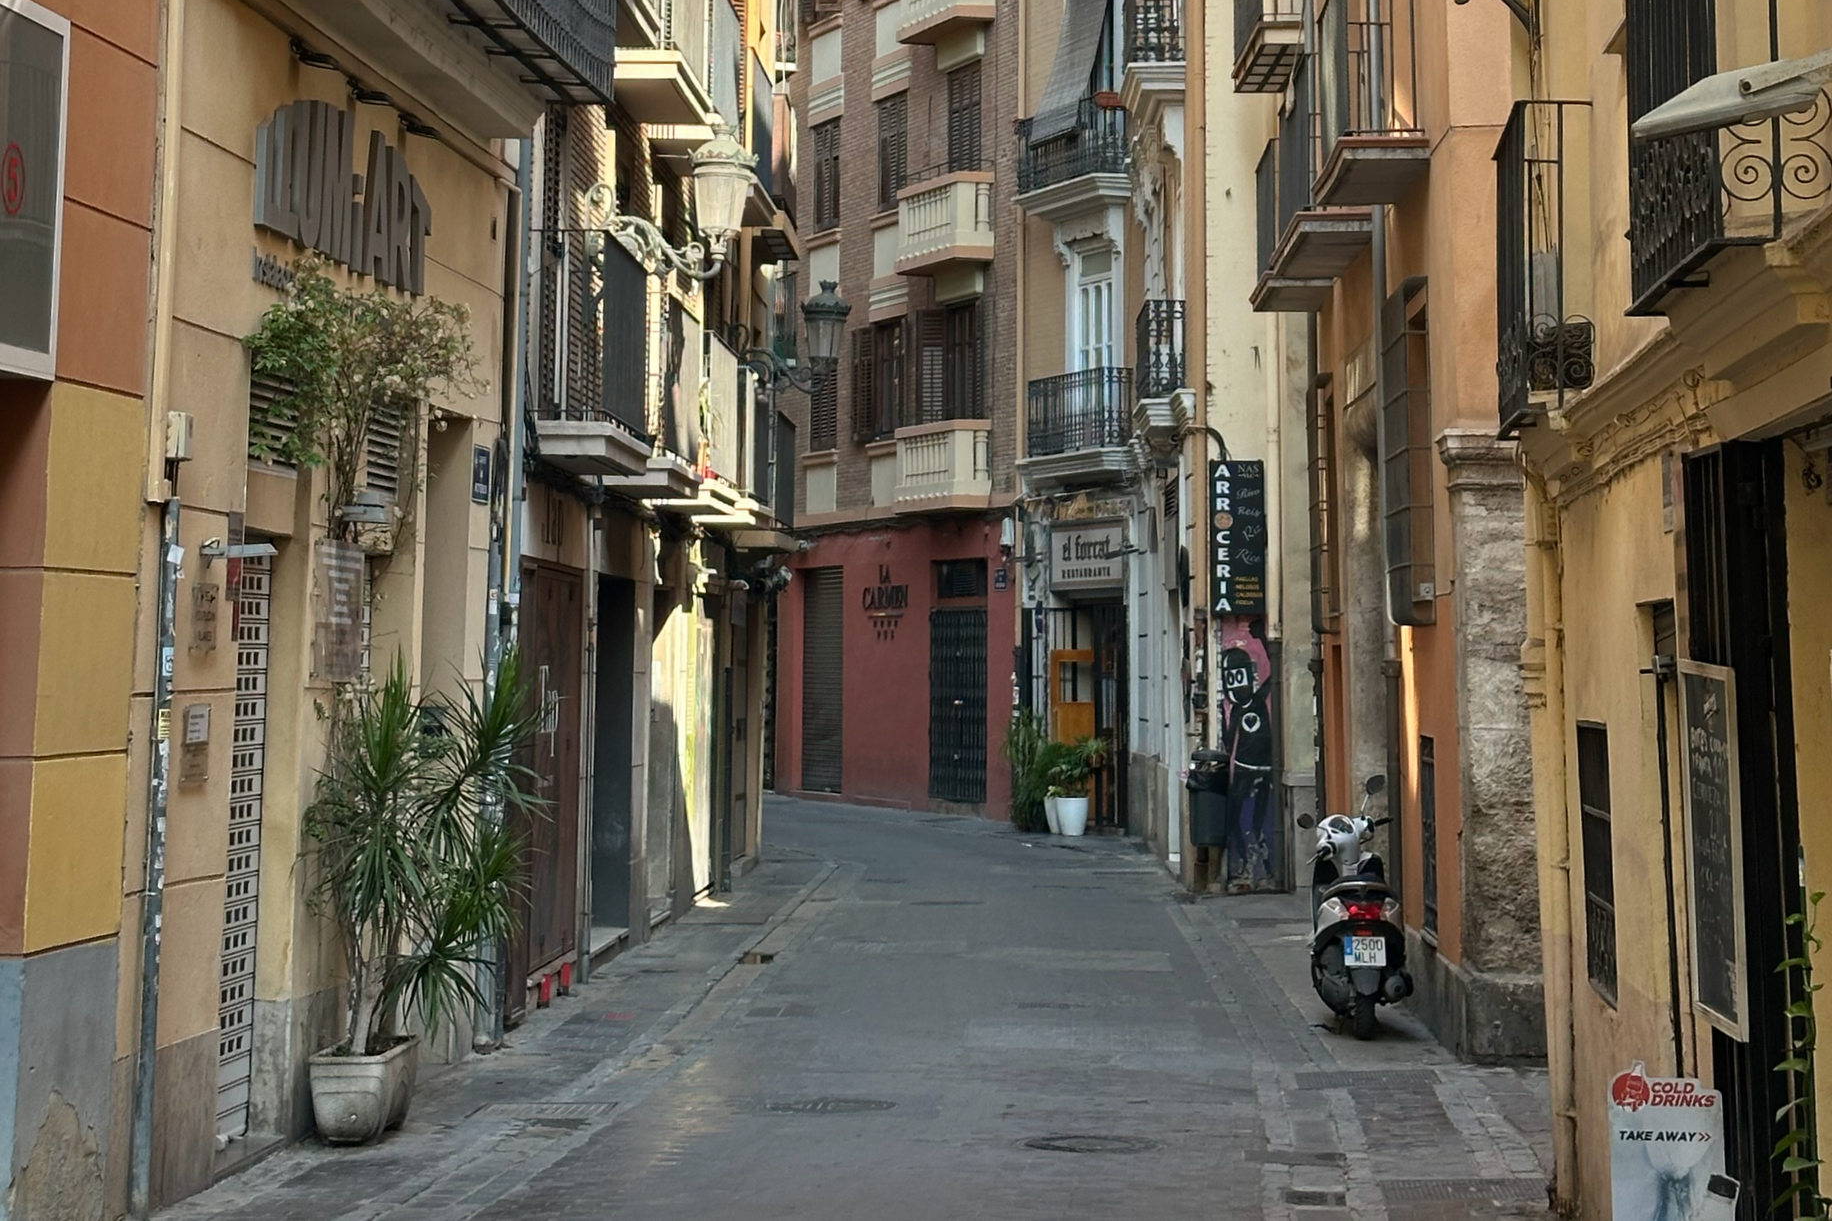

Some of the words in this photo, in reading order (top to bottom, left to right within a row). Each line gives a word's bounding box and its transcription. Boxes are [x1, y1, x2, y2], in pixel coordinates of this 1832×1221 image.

[7, 156, 20, 203] 5
[1062, 535, 1072, 561] el
[1235, 548, 1262, 565] Rice
[879, 564, 891, 584] LA
[1061, 566, 1111, 579] RESTAURANTE
[862, 584, 909, 610] CARMEN
[1354, 939, 1383, 951] 2500
[1354, 952, 1377, 963] MLH
[1651, 1082, 1695, 1094] COLD
[1651, 1094, 1716, 1108] DRINKS
[1619, 1130, 1653, 1141] TAKE
[1655, 1131, 1696, 1142] AWAY
